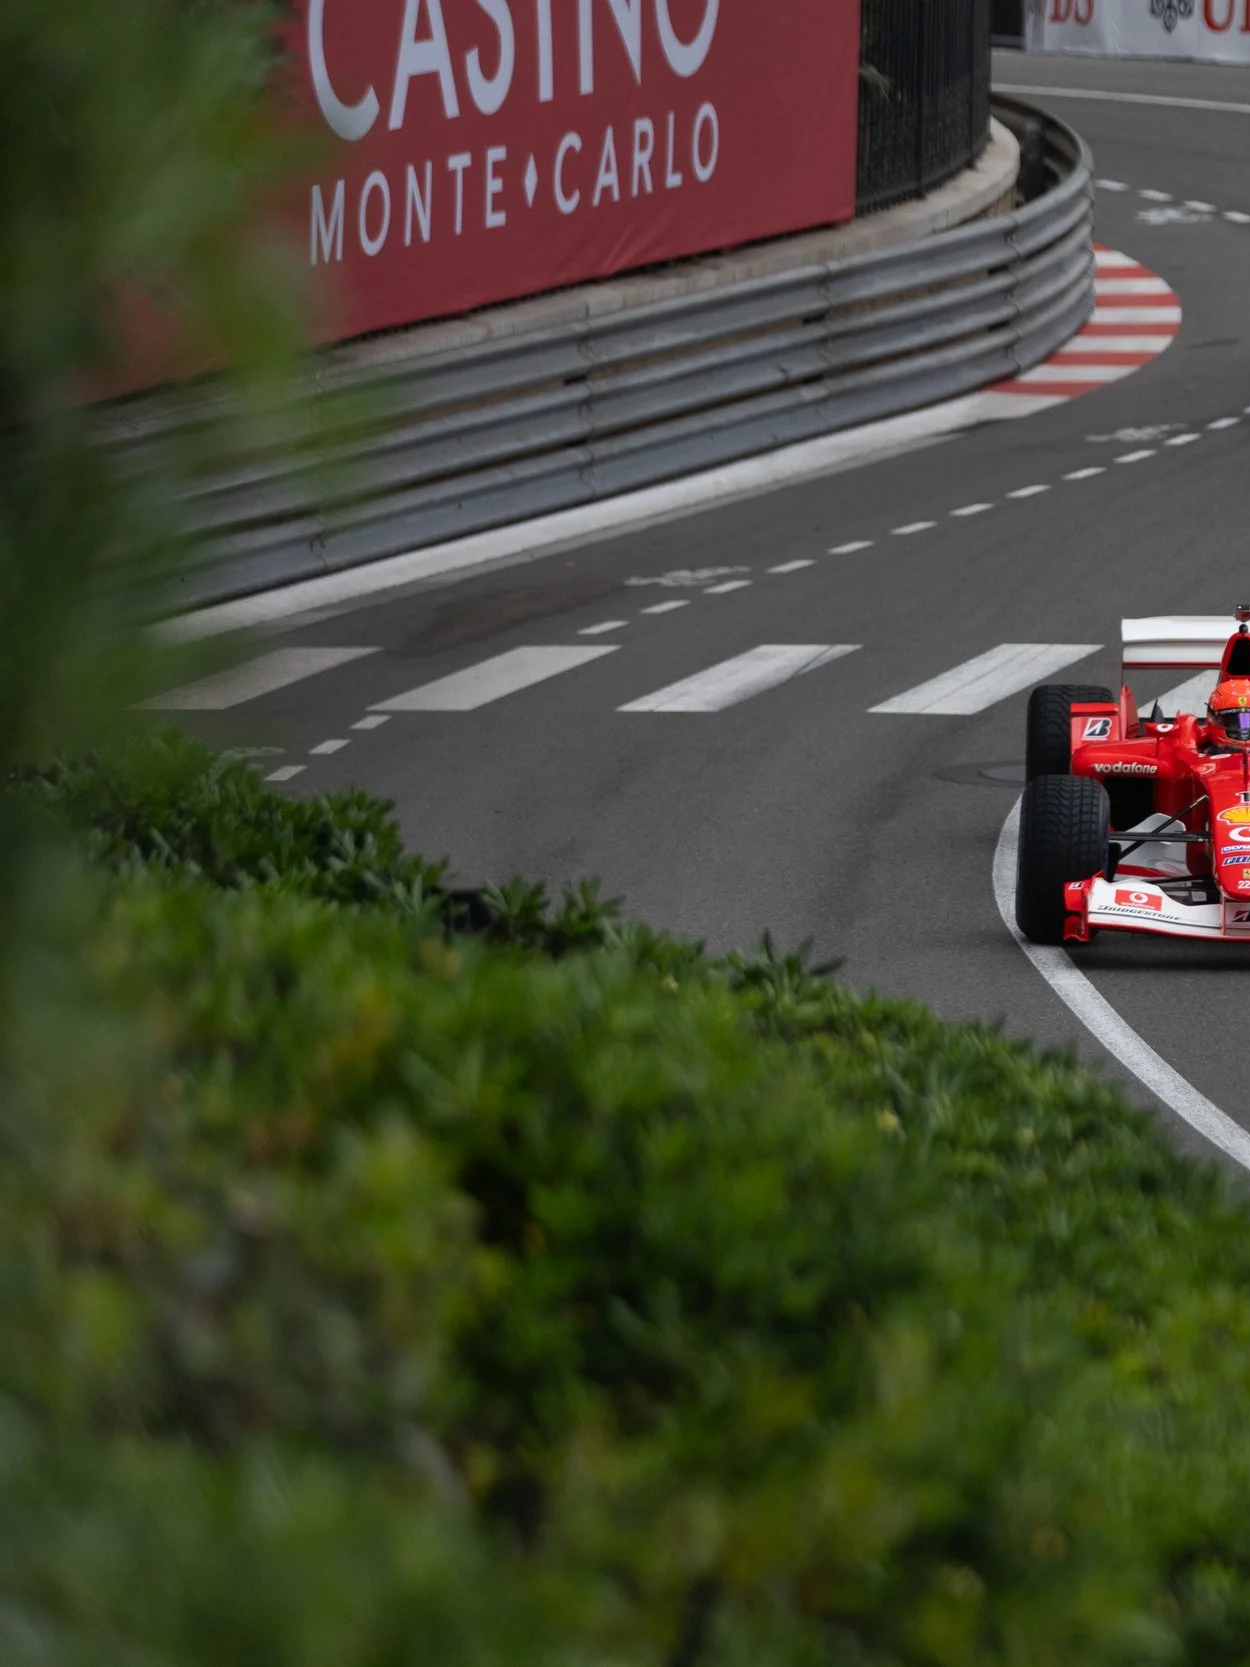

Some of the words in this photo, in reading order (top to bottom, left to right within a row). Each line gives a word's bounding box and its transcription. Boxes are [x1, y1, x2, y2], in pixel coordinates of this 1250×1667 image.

[310, 146, 507, 267] MONTE
[553, 101, 719, 214] CARLO
[1094, 761, 1158, 773] vodafone
